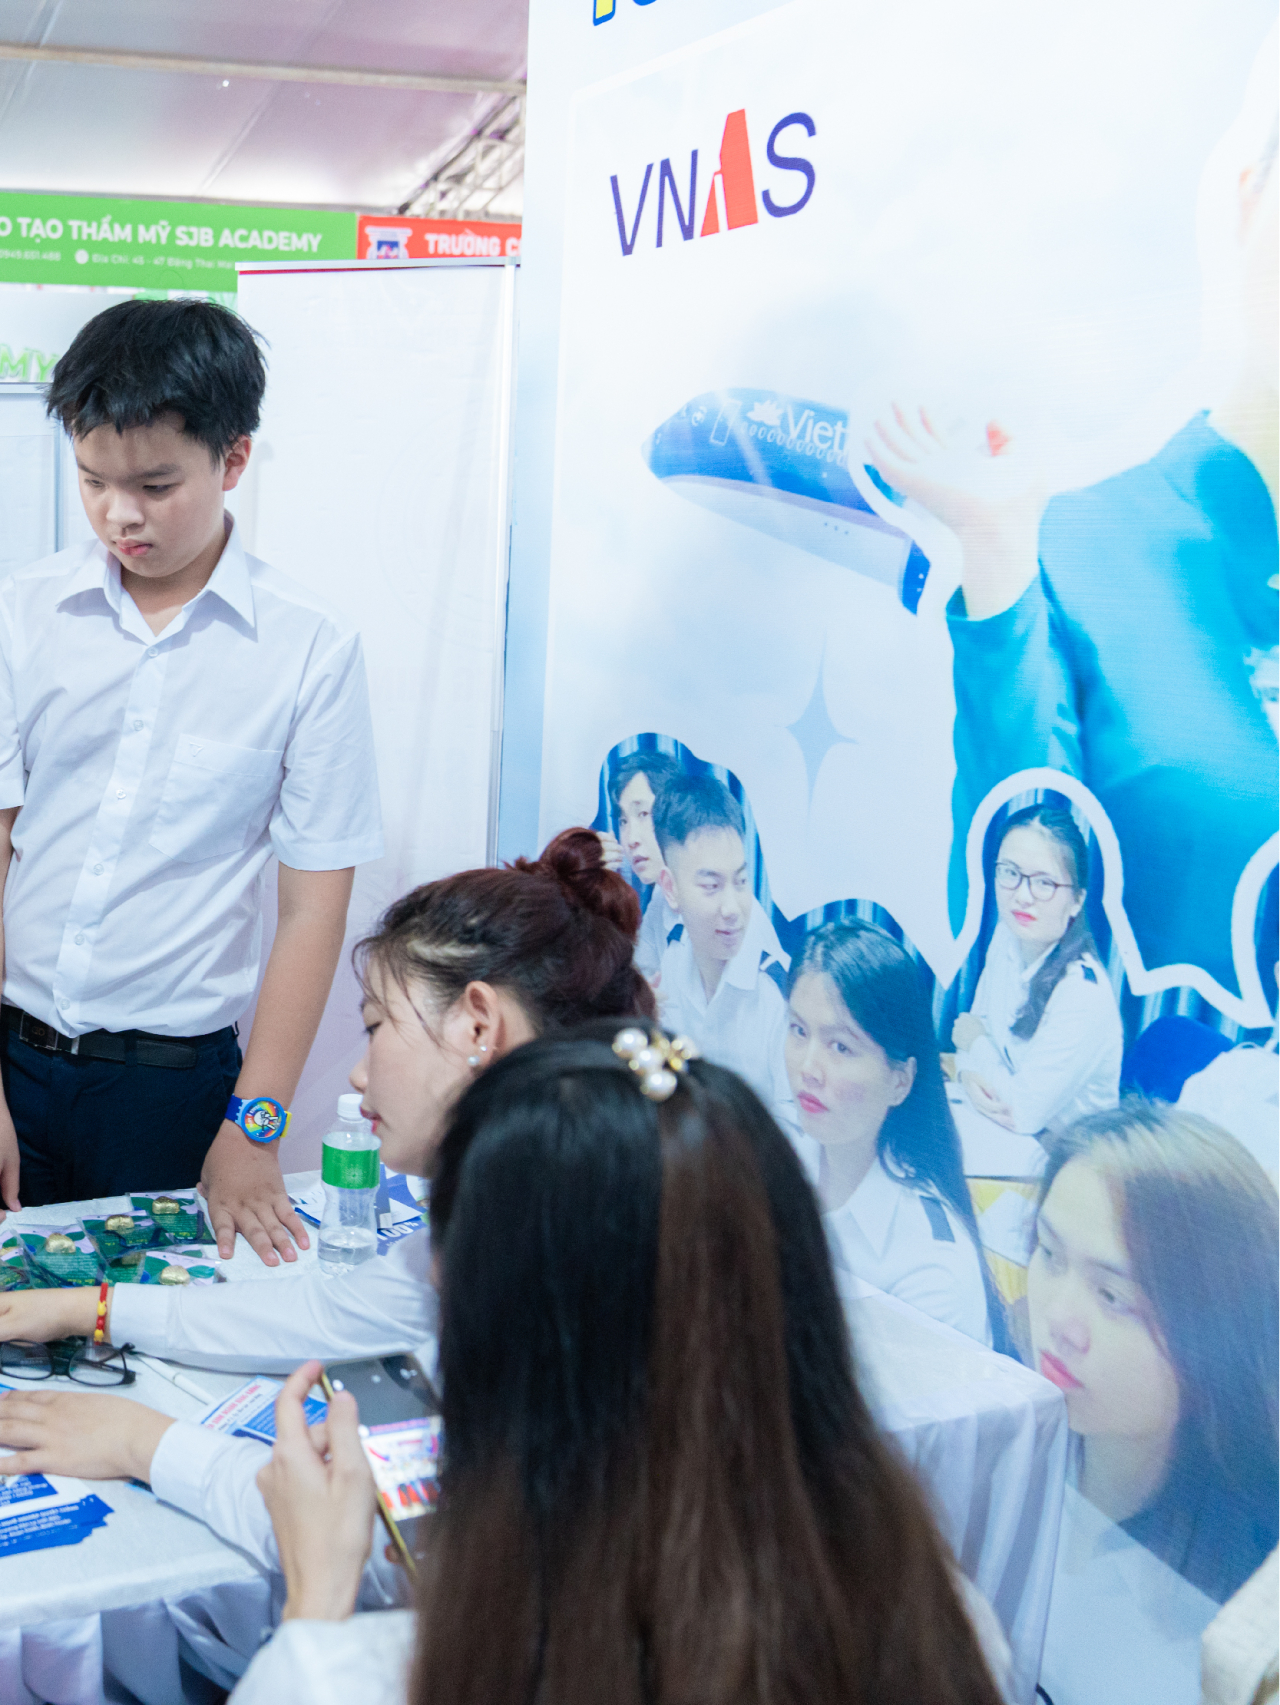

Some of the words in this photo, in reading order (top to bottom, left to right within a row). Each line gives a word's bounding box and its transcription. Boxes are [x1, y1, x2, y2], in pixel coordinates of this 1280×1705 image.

[17, 217, 64, 243] TẠO
[137, 220, 171, 245] MỸ
[175, 226, 214, 248] SJB
[219, 228, 323, 253] ACADEMY
[424, 228, 501, 257] TRƯỜNG
[505, 236, 522, 257] C
